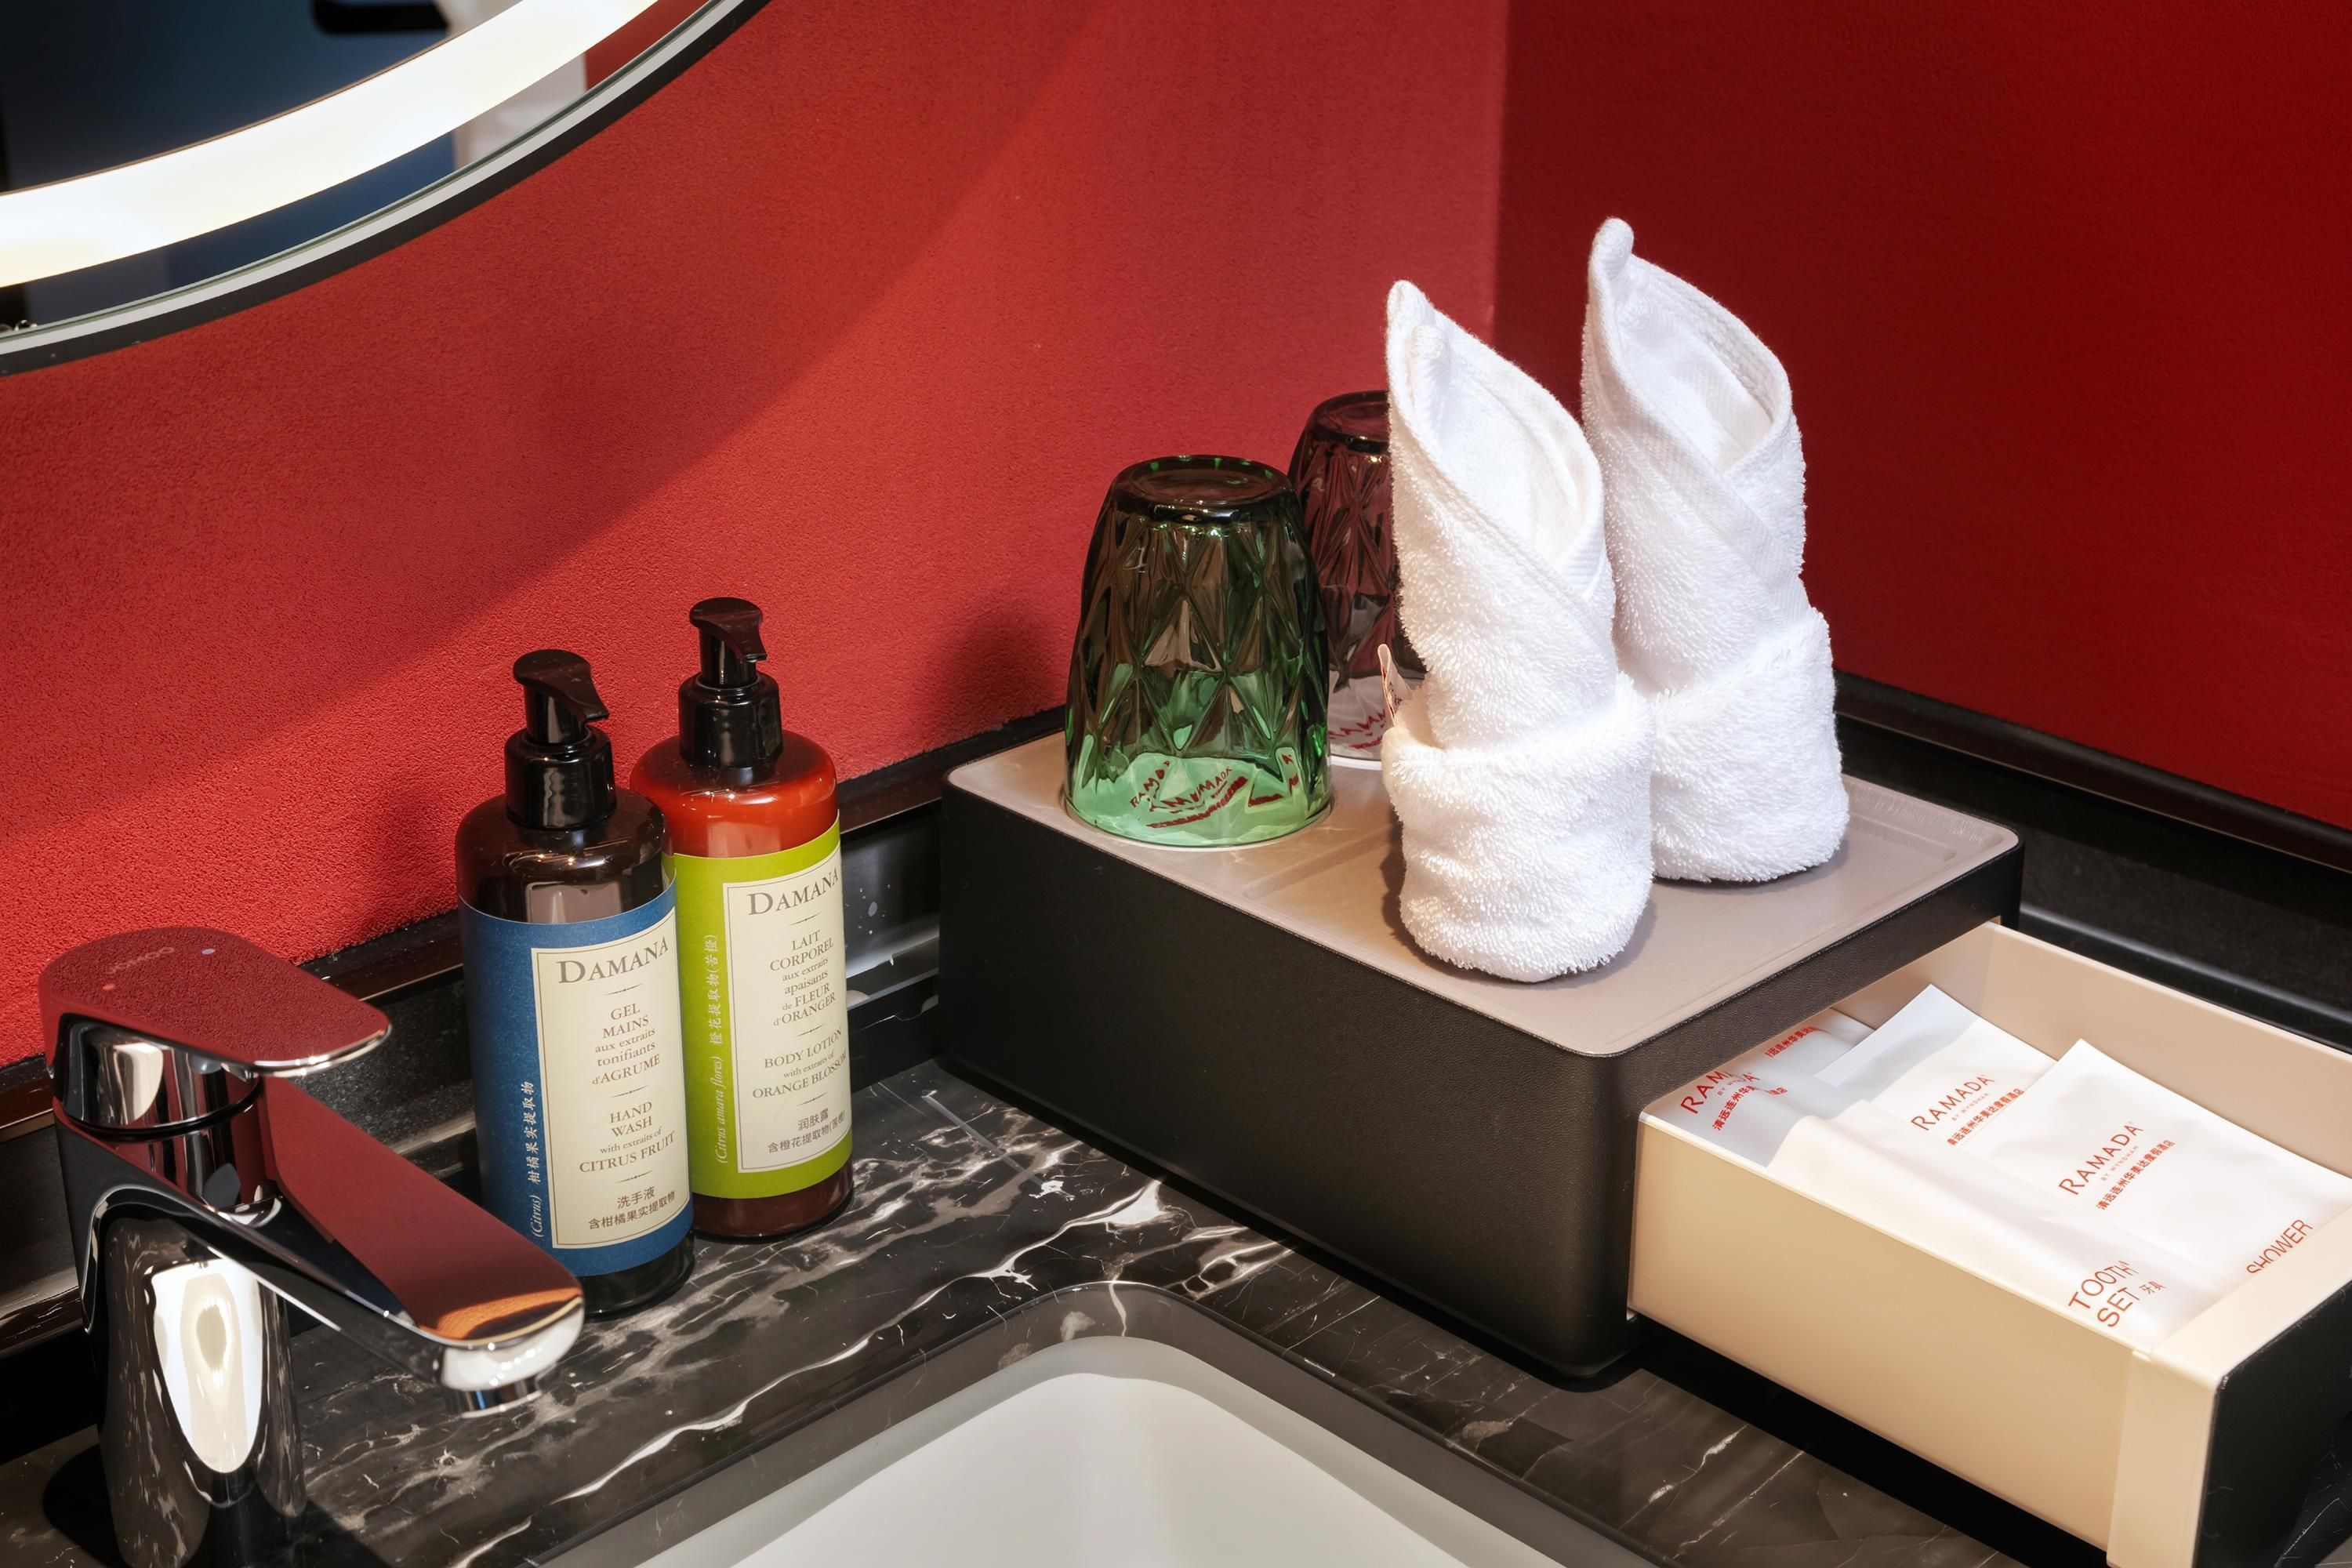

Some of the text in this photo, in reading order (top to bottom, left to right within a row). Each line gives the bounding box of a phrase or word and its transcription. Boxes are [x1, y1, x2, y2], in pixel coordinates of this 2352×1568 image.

[746, 866, 839, 916] DAMANA
[770, 937, 834, 971] CORPOREL
[791, 929, 820, 951] LAIT
[556, 935, 669, 984] DAMANA
[782, 957, 829, 982] aux extraits
[782, 982, 830, 1011] de FLEUR
[784, 971, 828, 996] apaisants
[610, 1003, 641, 1020] GEL
[773, 992, 836, 1026] d'ORANGER
[595, 1029, 655, 1053] aux extraits
[602, 1014, 649, 1039] MAINS
[597, 1042, 655, 1066] tonifiants
[764, 1025, 842, 1069] BODY LOTION
[784, 1049, 835, 1079] with extraits of
[592, 1054, 660, 1085] d'AGRUME
[753, 1048, 848, 1098] ORANGE BLOSSOM
[609, 1102, 652, 1123] HAND
[715, 1089, 726, 1125] amara
[797, 1107, 829, 1131] 润肤露
[1911, 1076, 1995, 1131] RAMADA
[521, 1081, 541, 1185] 柑橘果实提取物
[600, 1126, 662, 1154] with extraits of
[612, 1116, 652, 1138] WASH
[579, 1131, 676, 1173] CITRUS FRUIT
[2058, 1124, 2144, 1195] RAMADA
[588, 1190, 676, 1230] 含柑橘果实提取物
[616, 1185, 656, 1210] 洗手液
[529, 1194, 545, 1238] (Citrus)
[2246, 1219, 2314, 1274] SHOWER
[2068, 1260, 2140, 1309] TOOTH
[2097, 1287, 2140, 1327] SET
